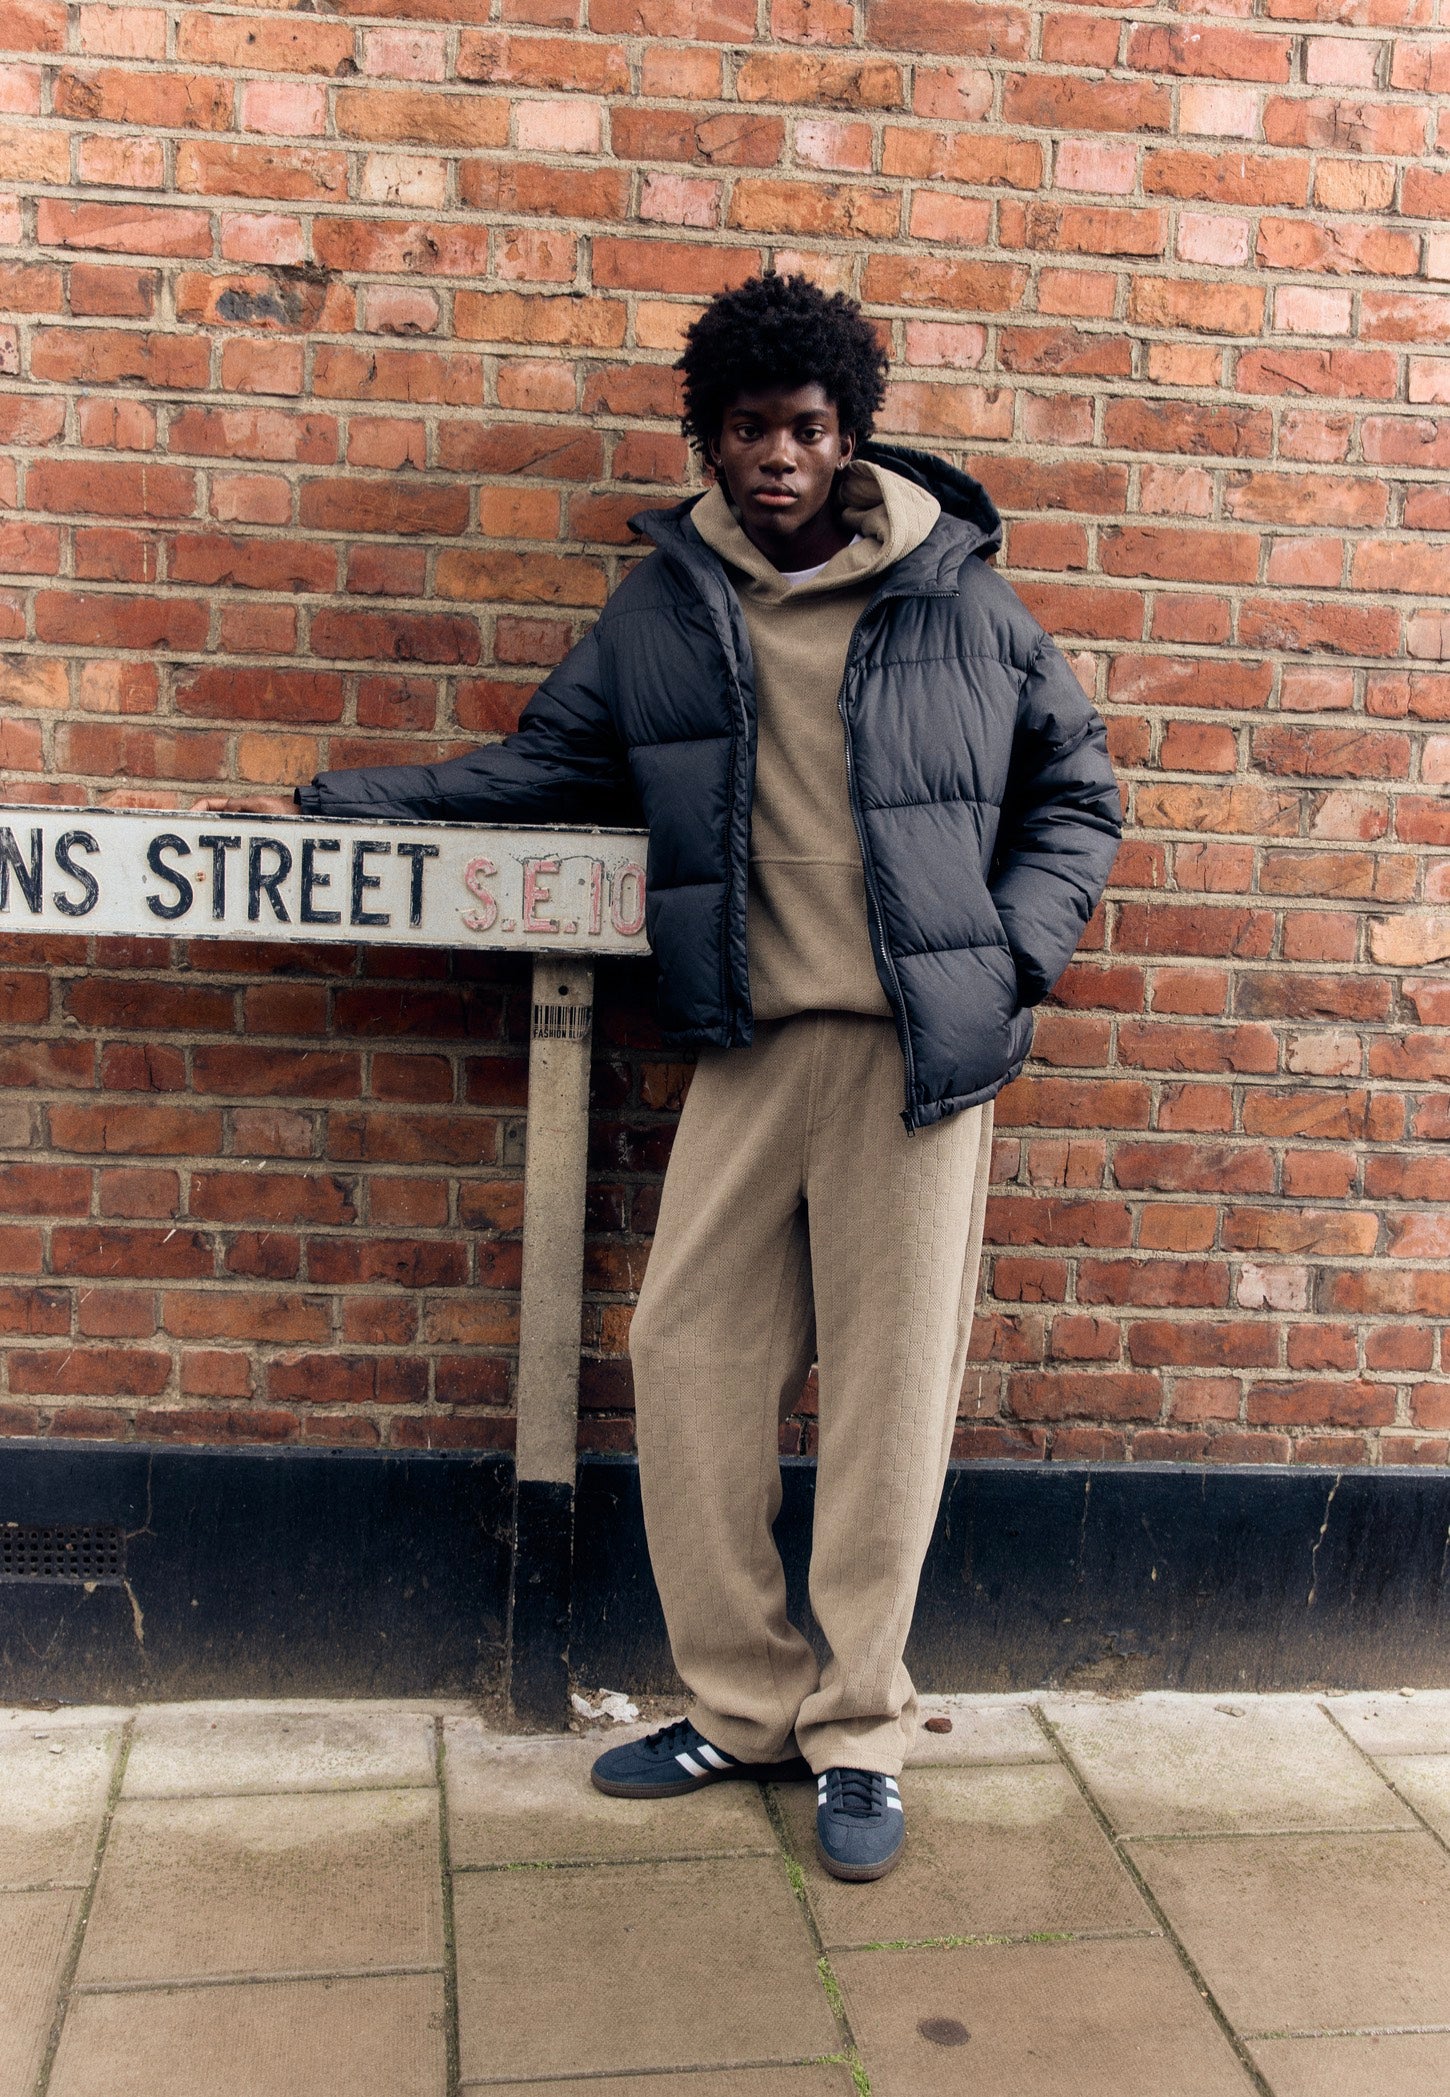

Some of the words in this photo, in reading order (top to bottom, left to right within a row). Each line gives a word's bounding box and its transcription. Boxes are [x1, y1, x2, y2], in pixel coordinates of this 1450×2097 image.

[0, 826, 101, 917] NS
[146, 832, 441, 929] STREET
[460, 855, 647, 936] S.E.10
[534, 1029, 567, 1038] FASHION
